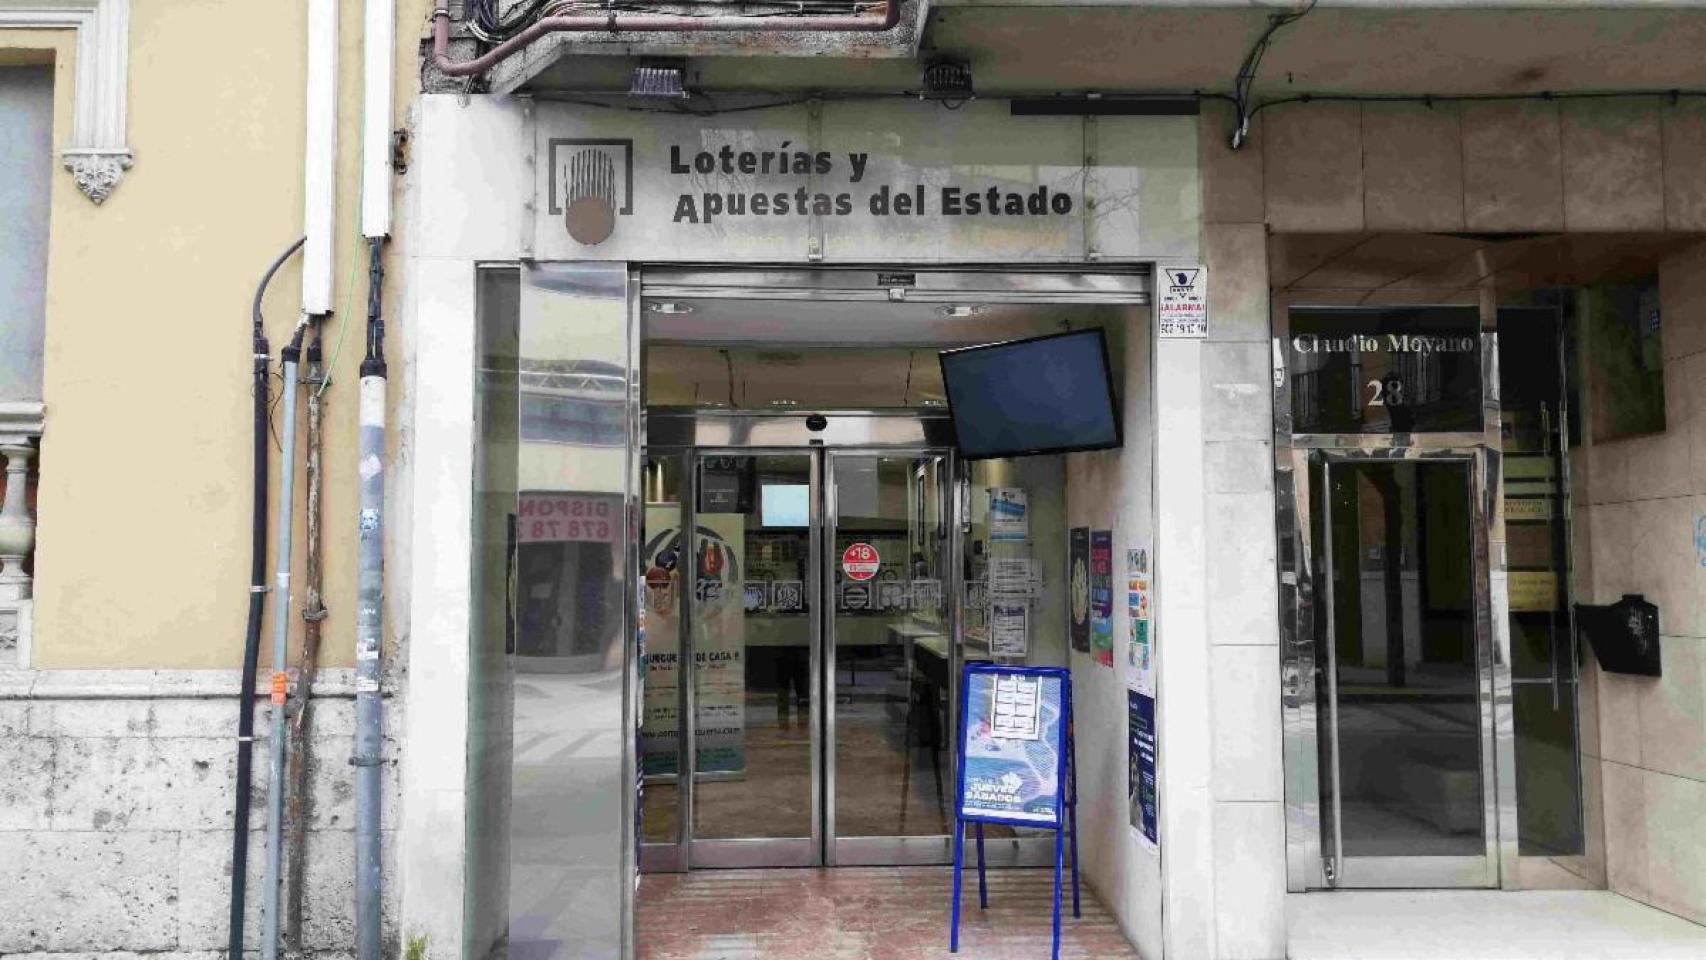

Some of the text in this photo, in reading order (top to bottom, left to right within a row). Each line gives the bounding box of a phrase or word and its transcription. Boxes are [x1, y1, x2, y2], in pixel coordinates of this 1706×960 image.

[670, 141, 869, 183] Loterías y
[673, 185, 1073, 224] Apuestas del Estado
[1293, 334, 1474, 357] Claudio Moyano
[1367, 379, 1404, 406] 28
[850, 547, 870, 560] +18
